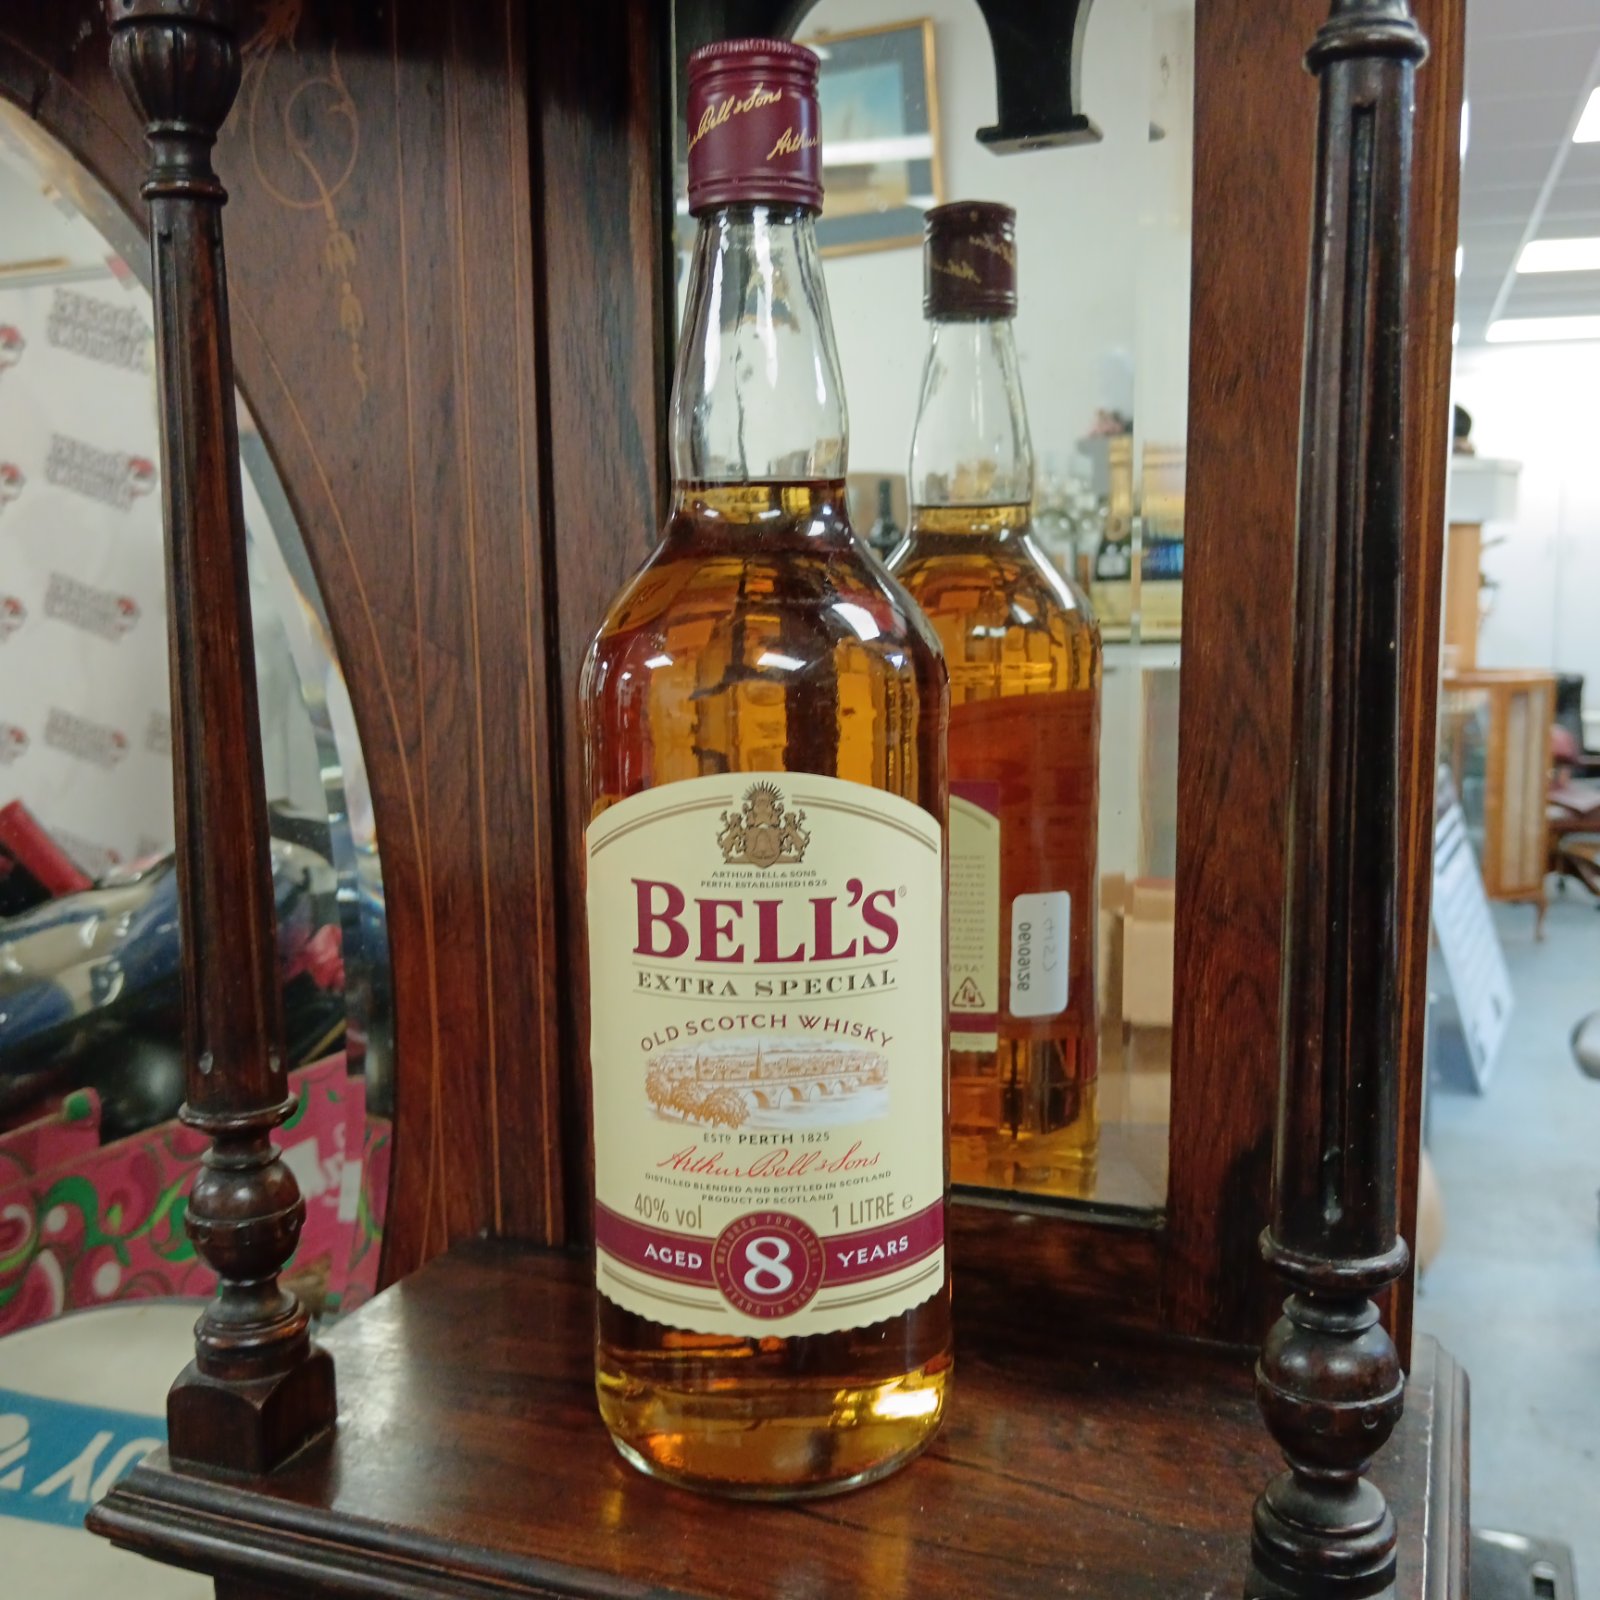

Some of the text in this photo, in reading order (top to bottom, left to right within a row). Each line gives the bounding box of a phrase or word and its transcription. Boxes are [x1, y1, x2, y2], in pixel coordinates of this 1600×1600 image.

[711, 870, 753, 879] ARTHUR
[755, 870, 779, 879] BELL
[790, 869, 817, 879] SONS
[631, 877, 900, 964] BELL'S
[637, 968, 896, 998] EXTRA SPECIAL
[640, 1013, 893, 1053] OLD SCOTCH WHISKY
[738, 1133, 794, 1146] PERTH
[800, 1131, 830, 1143] 1825
[656, 1144, 742, 1178] Arthur
[746, 1147, 823, 1178] Bell
[827, 1139, 881, 1174] Sons
[645, 1170, 892, 1194] DISTILLED BLENDED AND BOTTLED IN SCOTLAND
[701, 1192, 834, 1205] PRODUCT OF SCOTLAND
[633, 1192, 703, 1230] 40% vol
[831, 1204, 841, 1229] 1
[849, 1192, 895, 1226] LITRE
[644, 1242, 703, 1270] AGED
[743, 1236, 795, 1295] 8
[836, 1235, 909, 1268] YEARS
